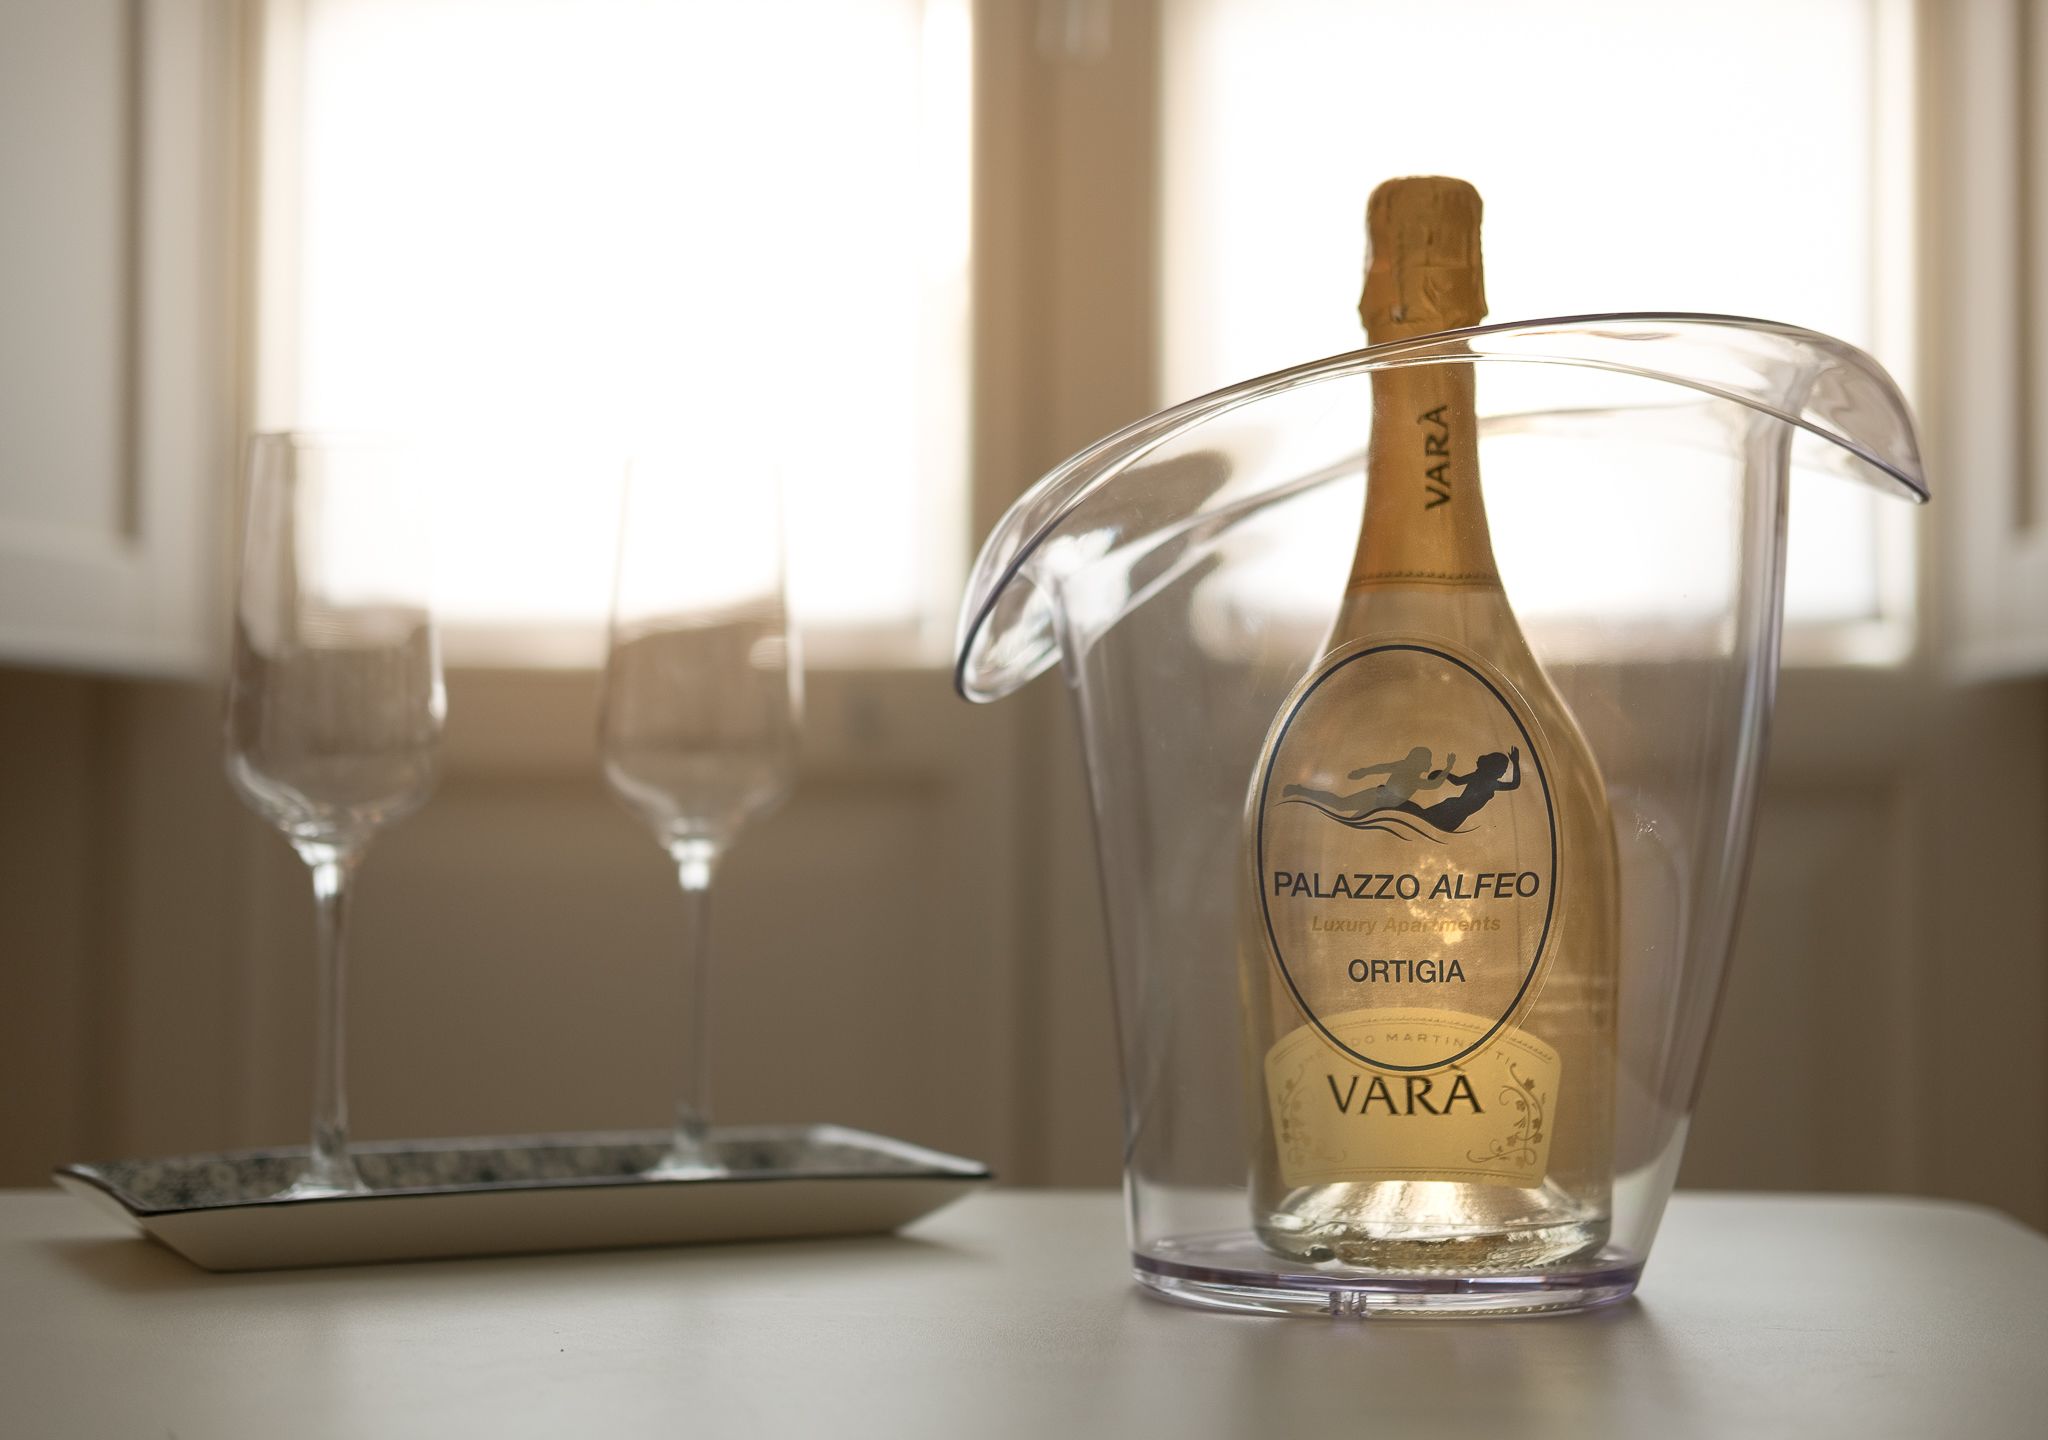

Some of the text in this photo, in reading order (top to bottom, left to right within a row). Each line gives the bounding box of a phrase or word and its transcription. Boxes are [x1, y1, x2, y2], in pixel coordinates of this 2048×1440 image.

[1417, 404, 1451, 511] VARÀ
[1274, 871, 1540, 900] PALAZZO ALFEO
[1312, 915, 1501, 935] Luxury Apartments
[1348, 958, 1466, 984] ORTIGIA
[1326, 1063, 1485, 1116] VARÀ
